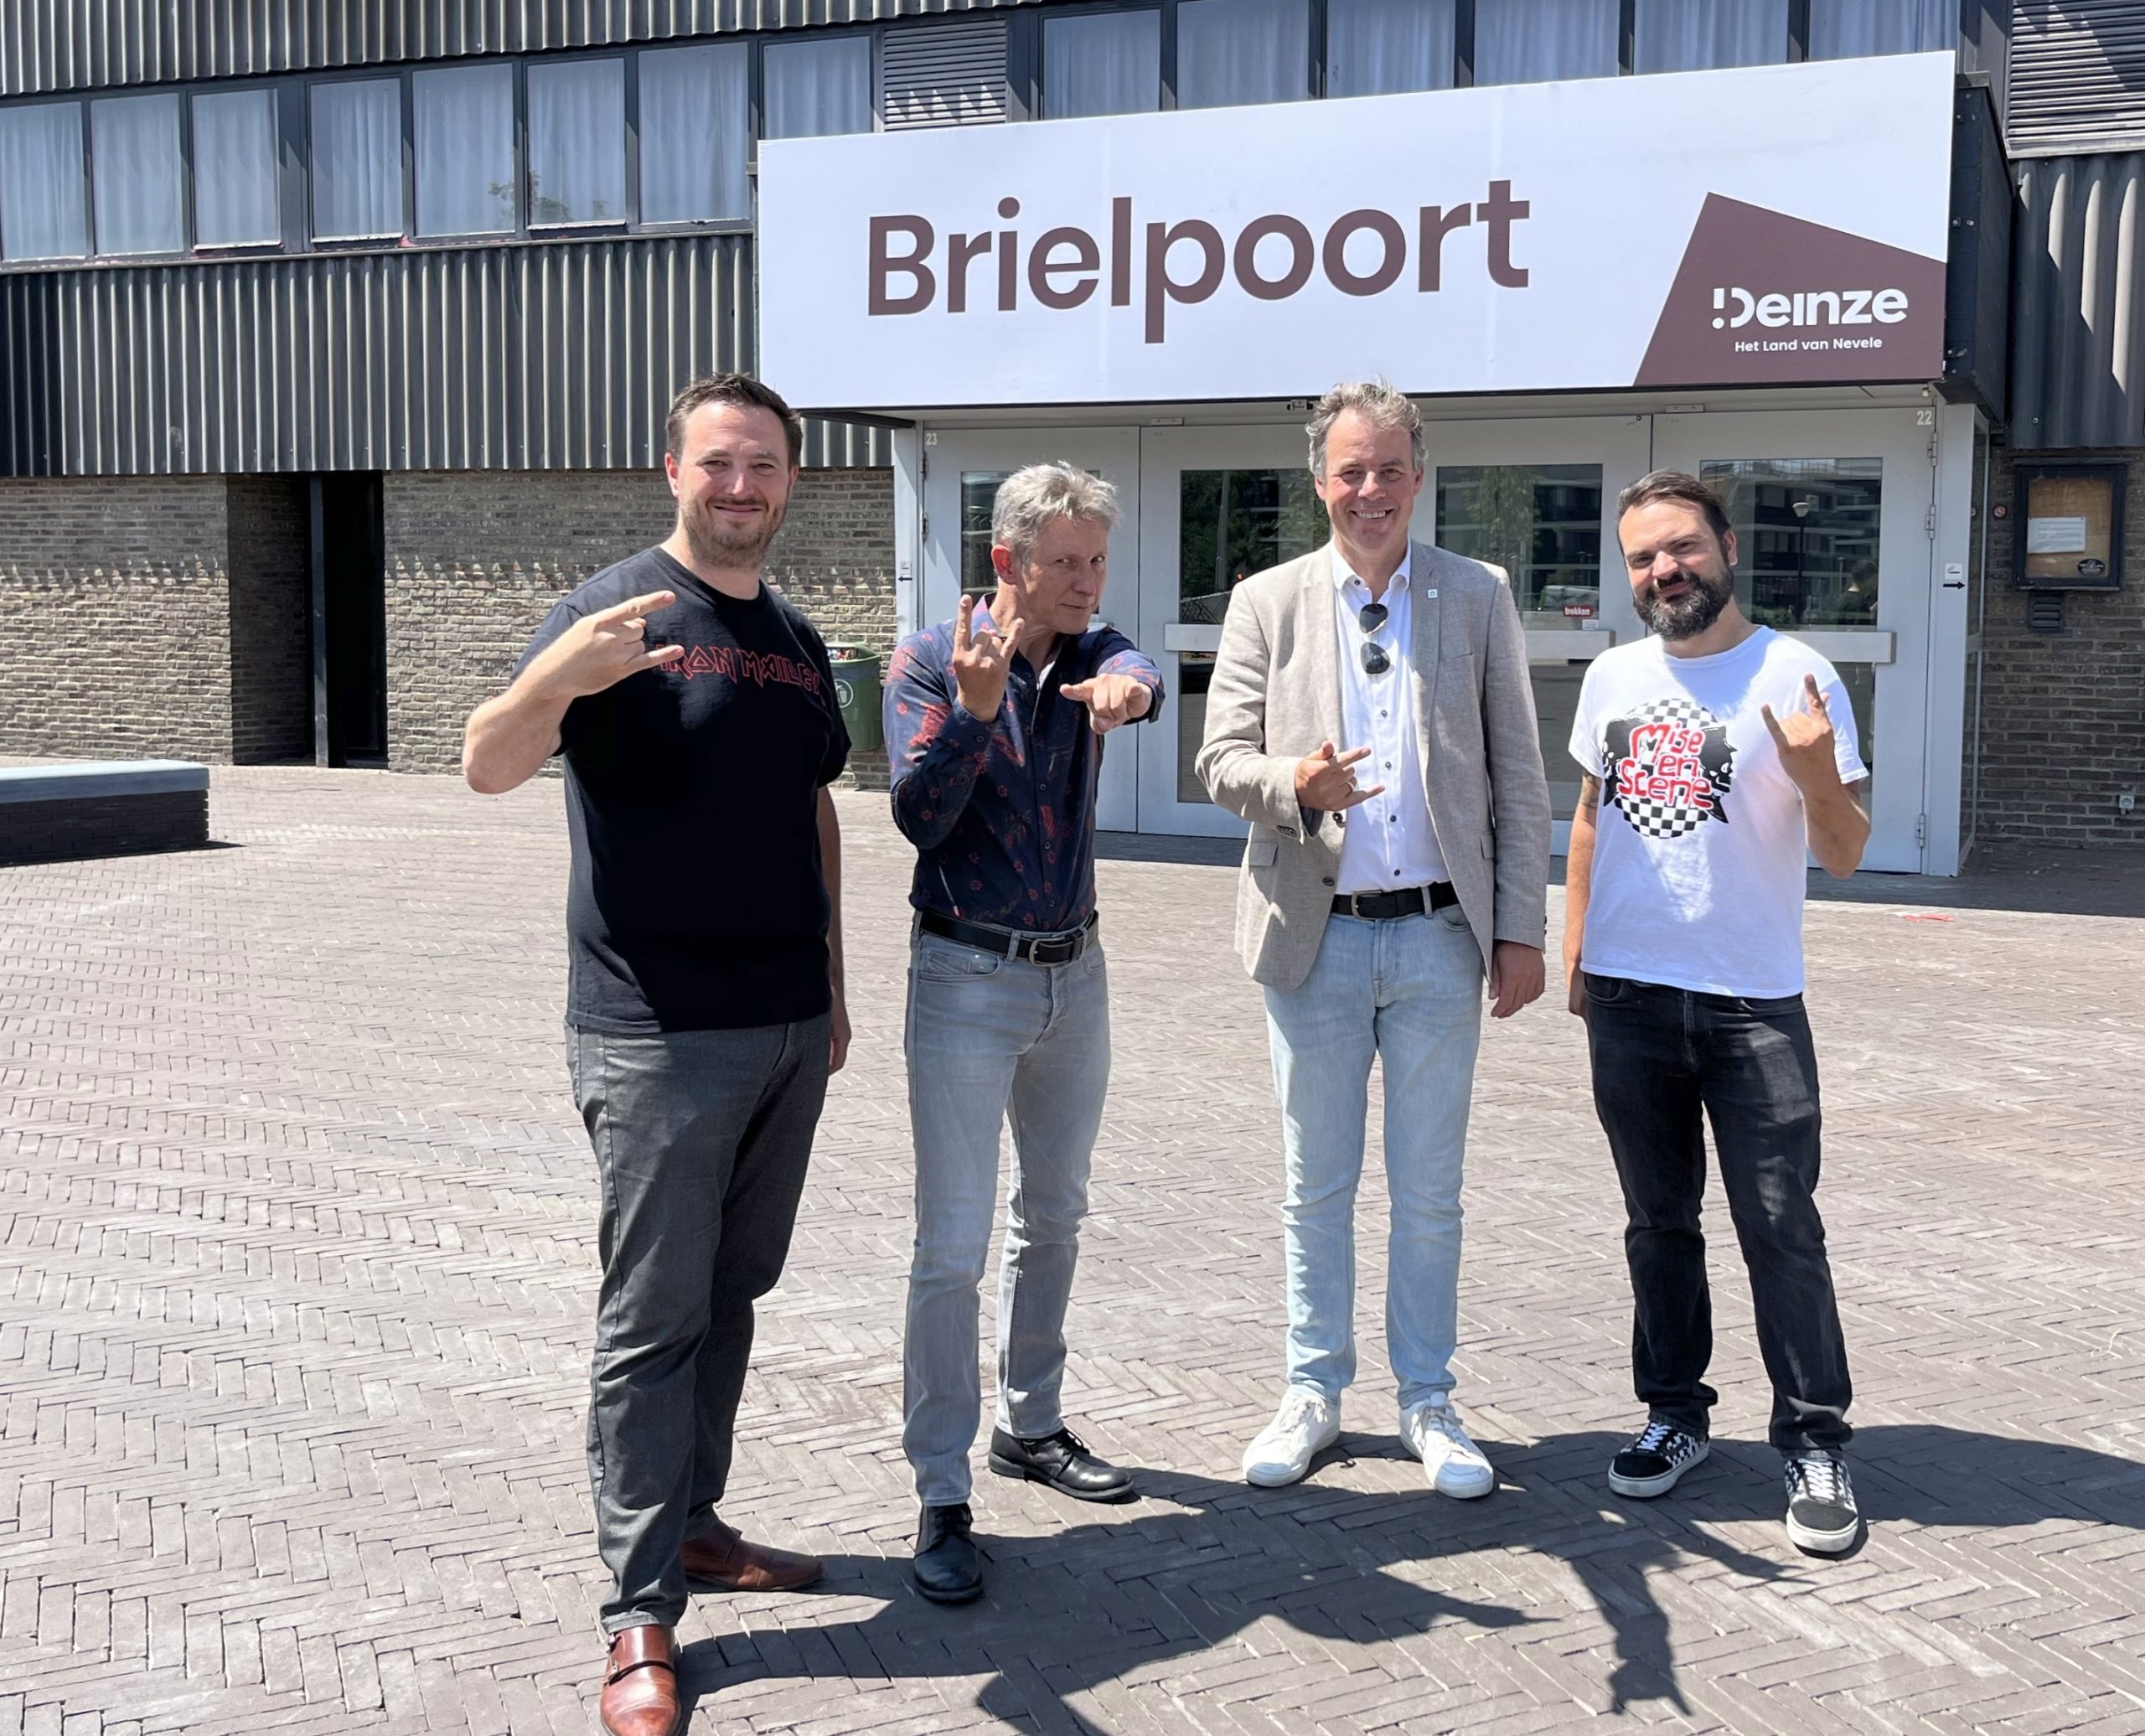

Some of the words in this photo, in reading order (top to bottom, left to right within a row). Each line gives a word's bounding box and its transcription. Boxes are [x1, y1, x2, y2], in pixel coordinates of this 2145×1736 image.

[868, 179, 1530, 344] Brielpoort
[1734, 341, 1759, 353] Het
[1762, 338, 1798, 352] Land
[1801, 340, 1829, 350] van
[1832, 337, 1883, 349] Nevele
[1916, 410, 1932, 426] 22
[926, 432, 938, 446] 23
[1564, 607, 1590, 616] trekken
[1631, 722, 1703, 763] Mise
[1658, 755, 1698, 777] en
[1617, 759, 1714, 809] Scene
